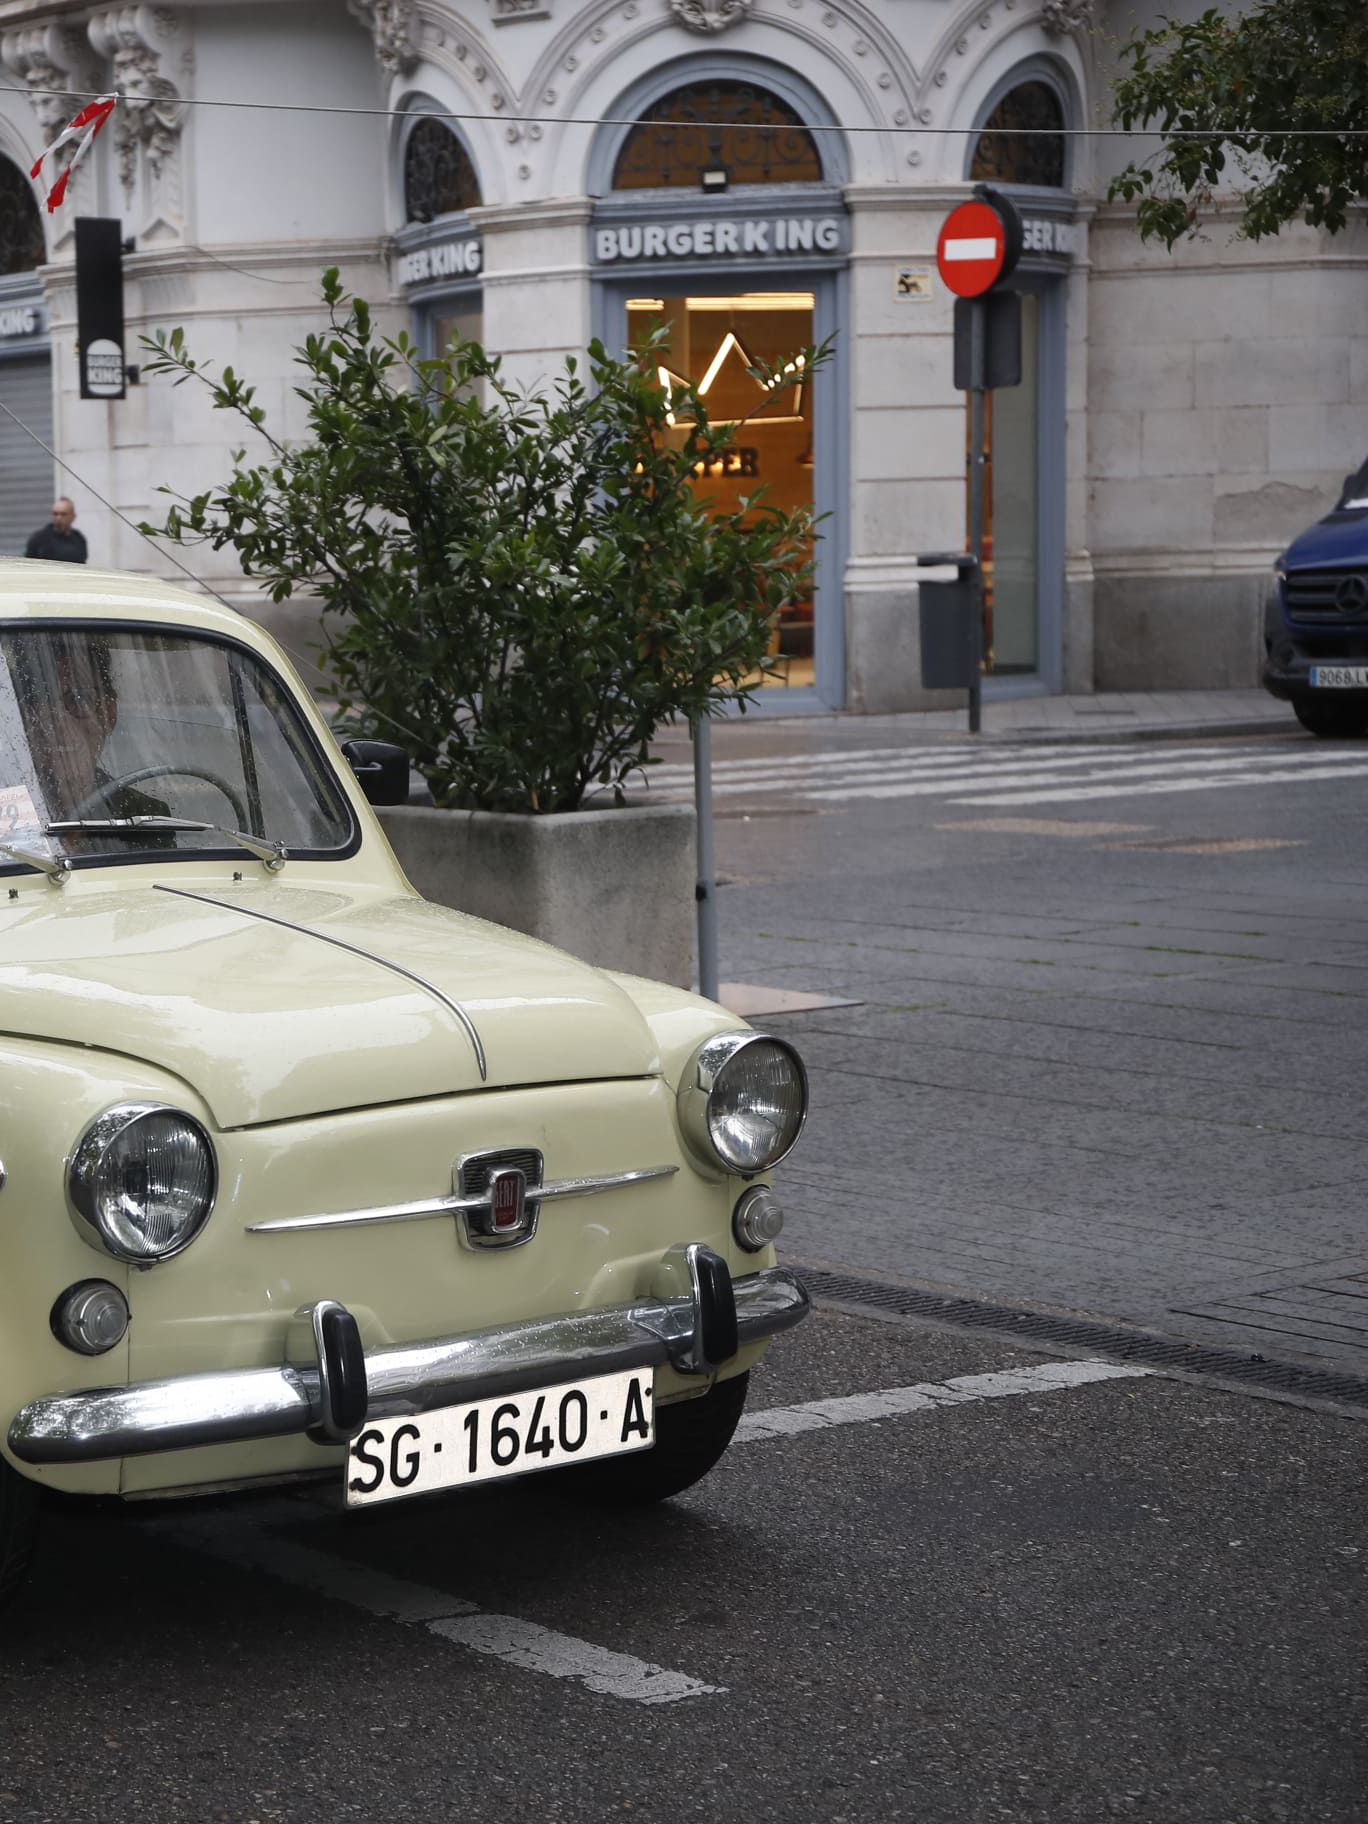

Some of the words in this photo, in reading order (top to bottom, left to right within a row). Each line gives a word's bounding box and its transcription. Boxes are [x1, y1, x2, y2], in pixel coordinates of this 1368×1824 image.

[596, 222, 738, 260] BURGER
[744, 219, 840, 251] KING
[431, 241, 480, 276] KING
[87, 368, 122, 384] KING
